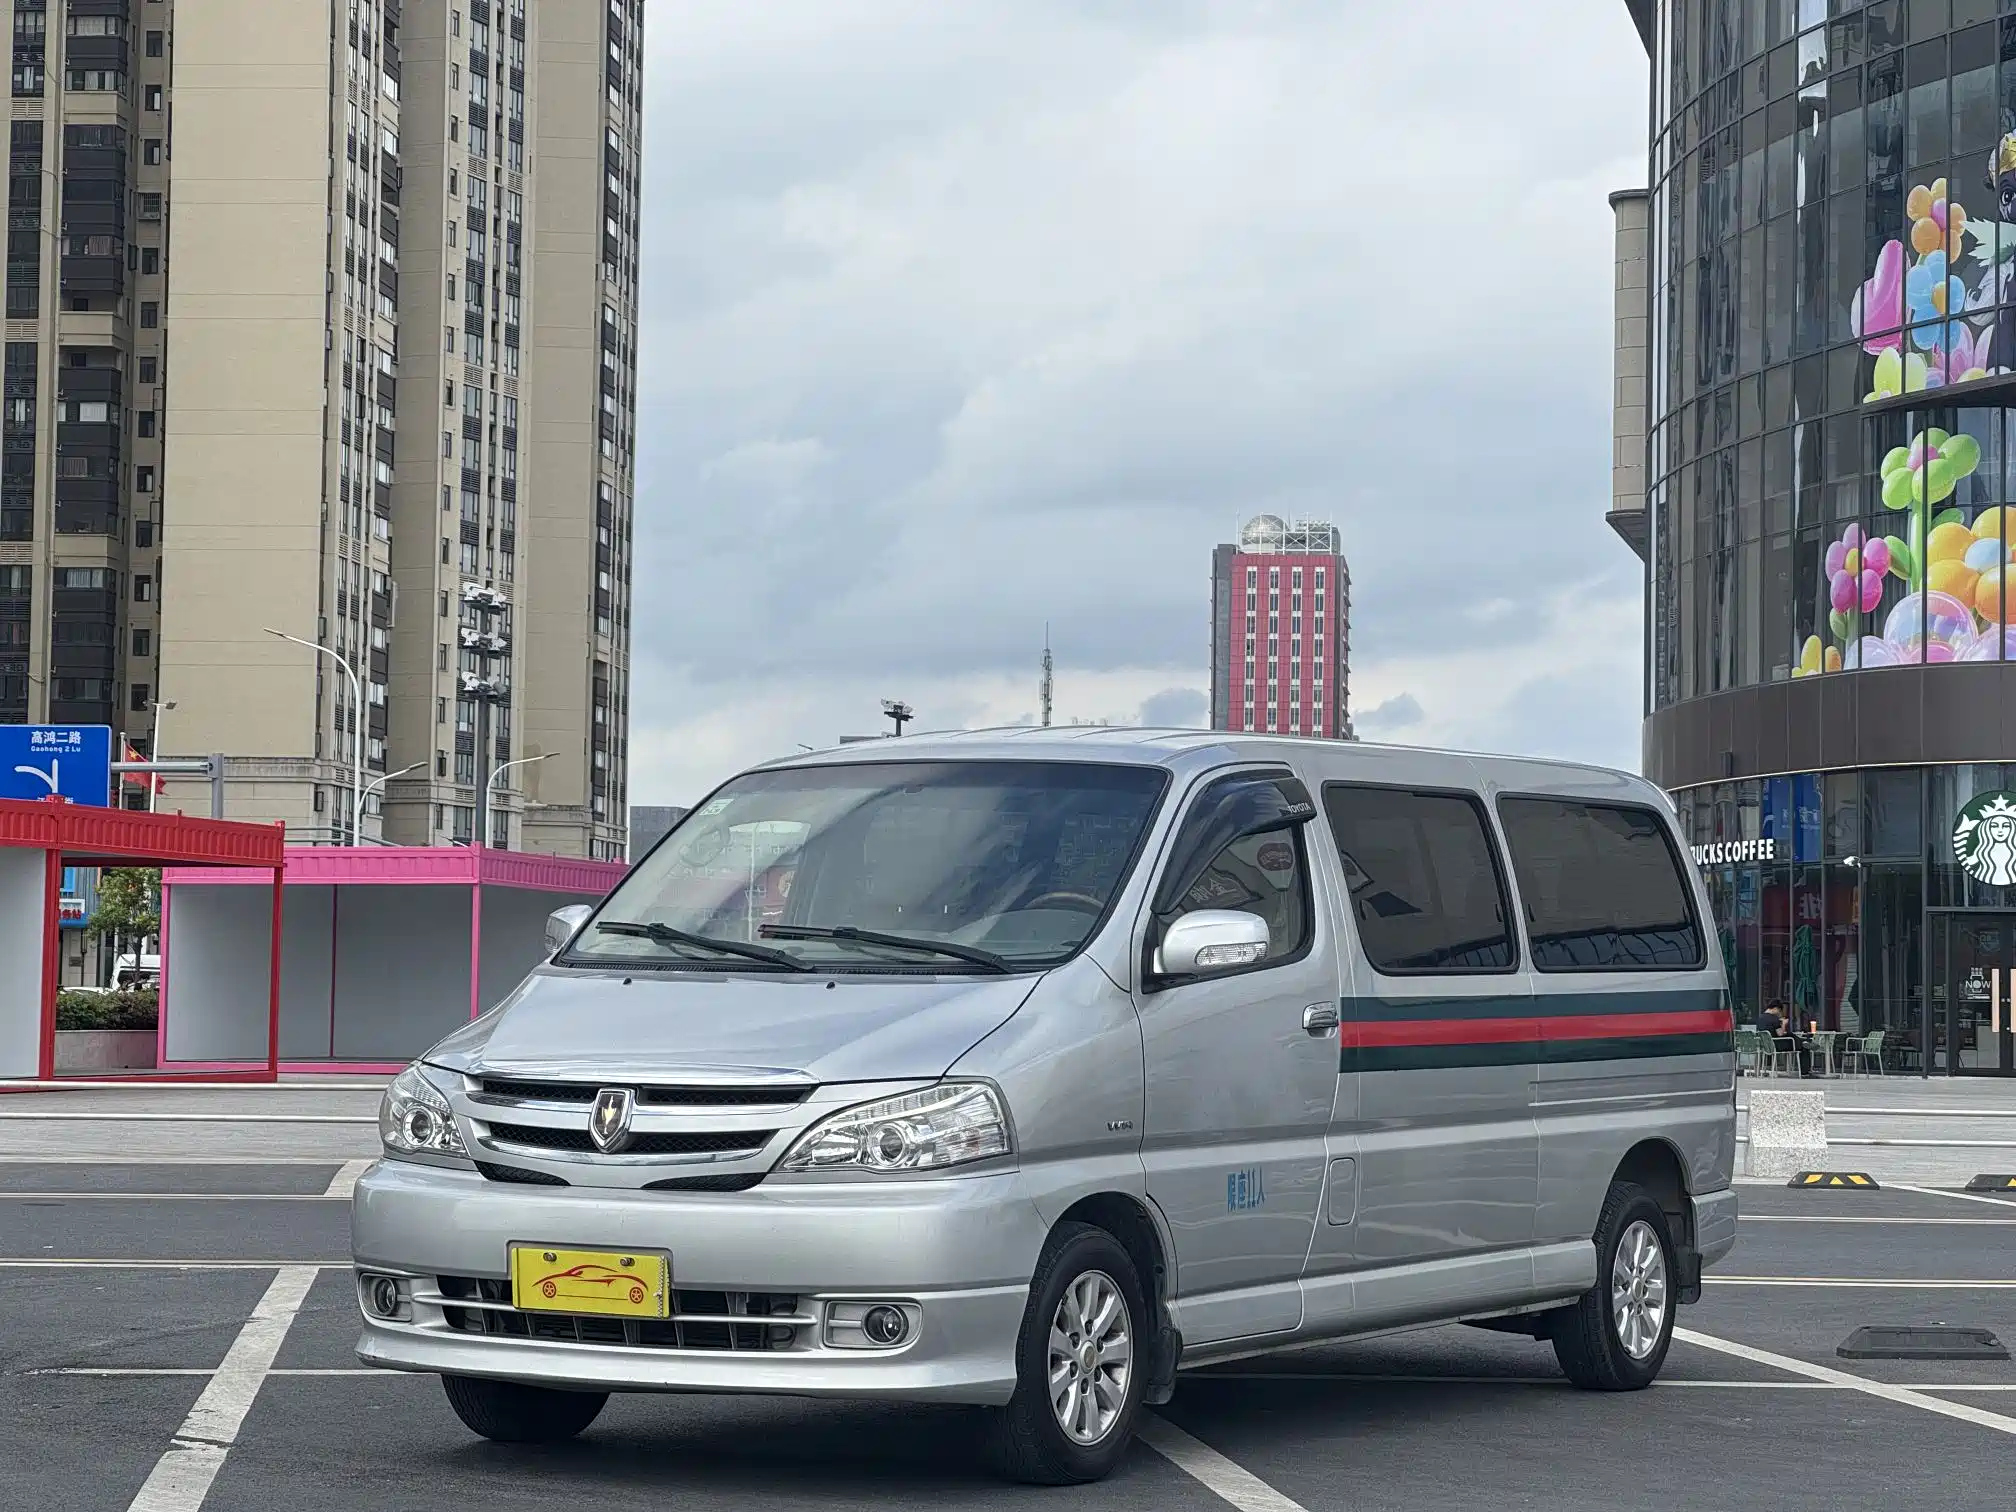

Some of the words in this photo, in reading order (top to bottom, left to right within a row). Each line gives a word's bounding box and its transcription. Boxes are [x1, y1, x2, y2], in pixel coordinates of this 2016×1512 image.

[31, 731, 81, 744] 高鸿二路
[31, 745, 63, 754] Gaohong
[1287, 802, 1311, 813] TOYOTA
[1725, 838, 1774, 863] COFFEE
